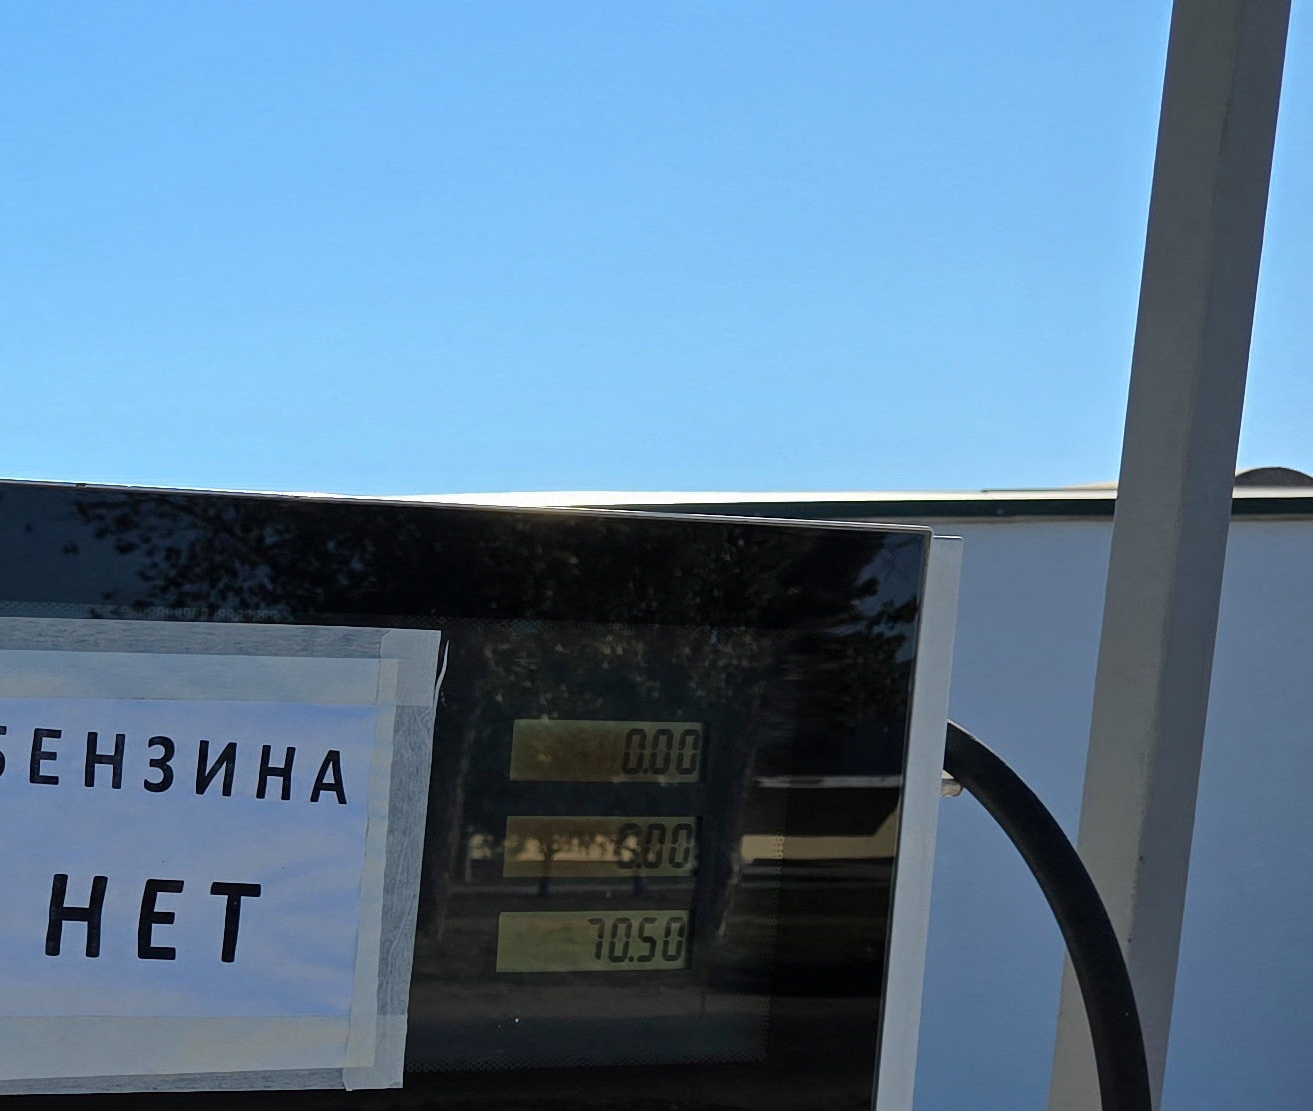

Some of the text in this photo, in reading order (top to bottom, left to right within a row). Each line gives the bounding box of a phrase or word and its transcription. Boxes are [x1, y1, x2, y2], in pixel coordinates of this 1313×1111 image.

[622, 728, 701, 775] 0.00
[45, 873, 261, 963] НЕТ
[588, 917, 686, 963] 70.50
